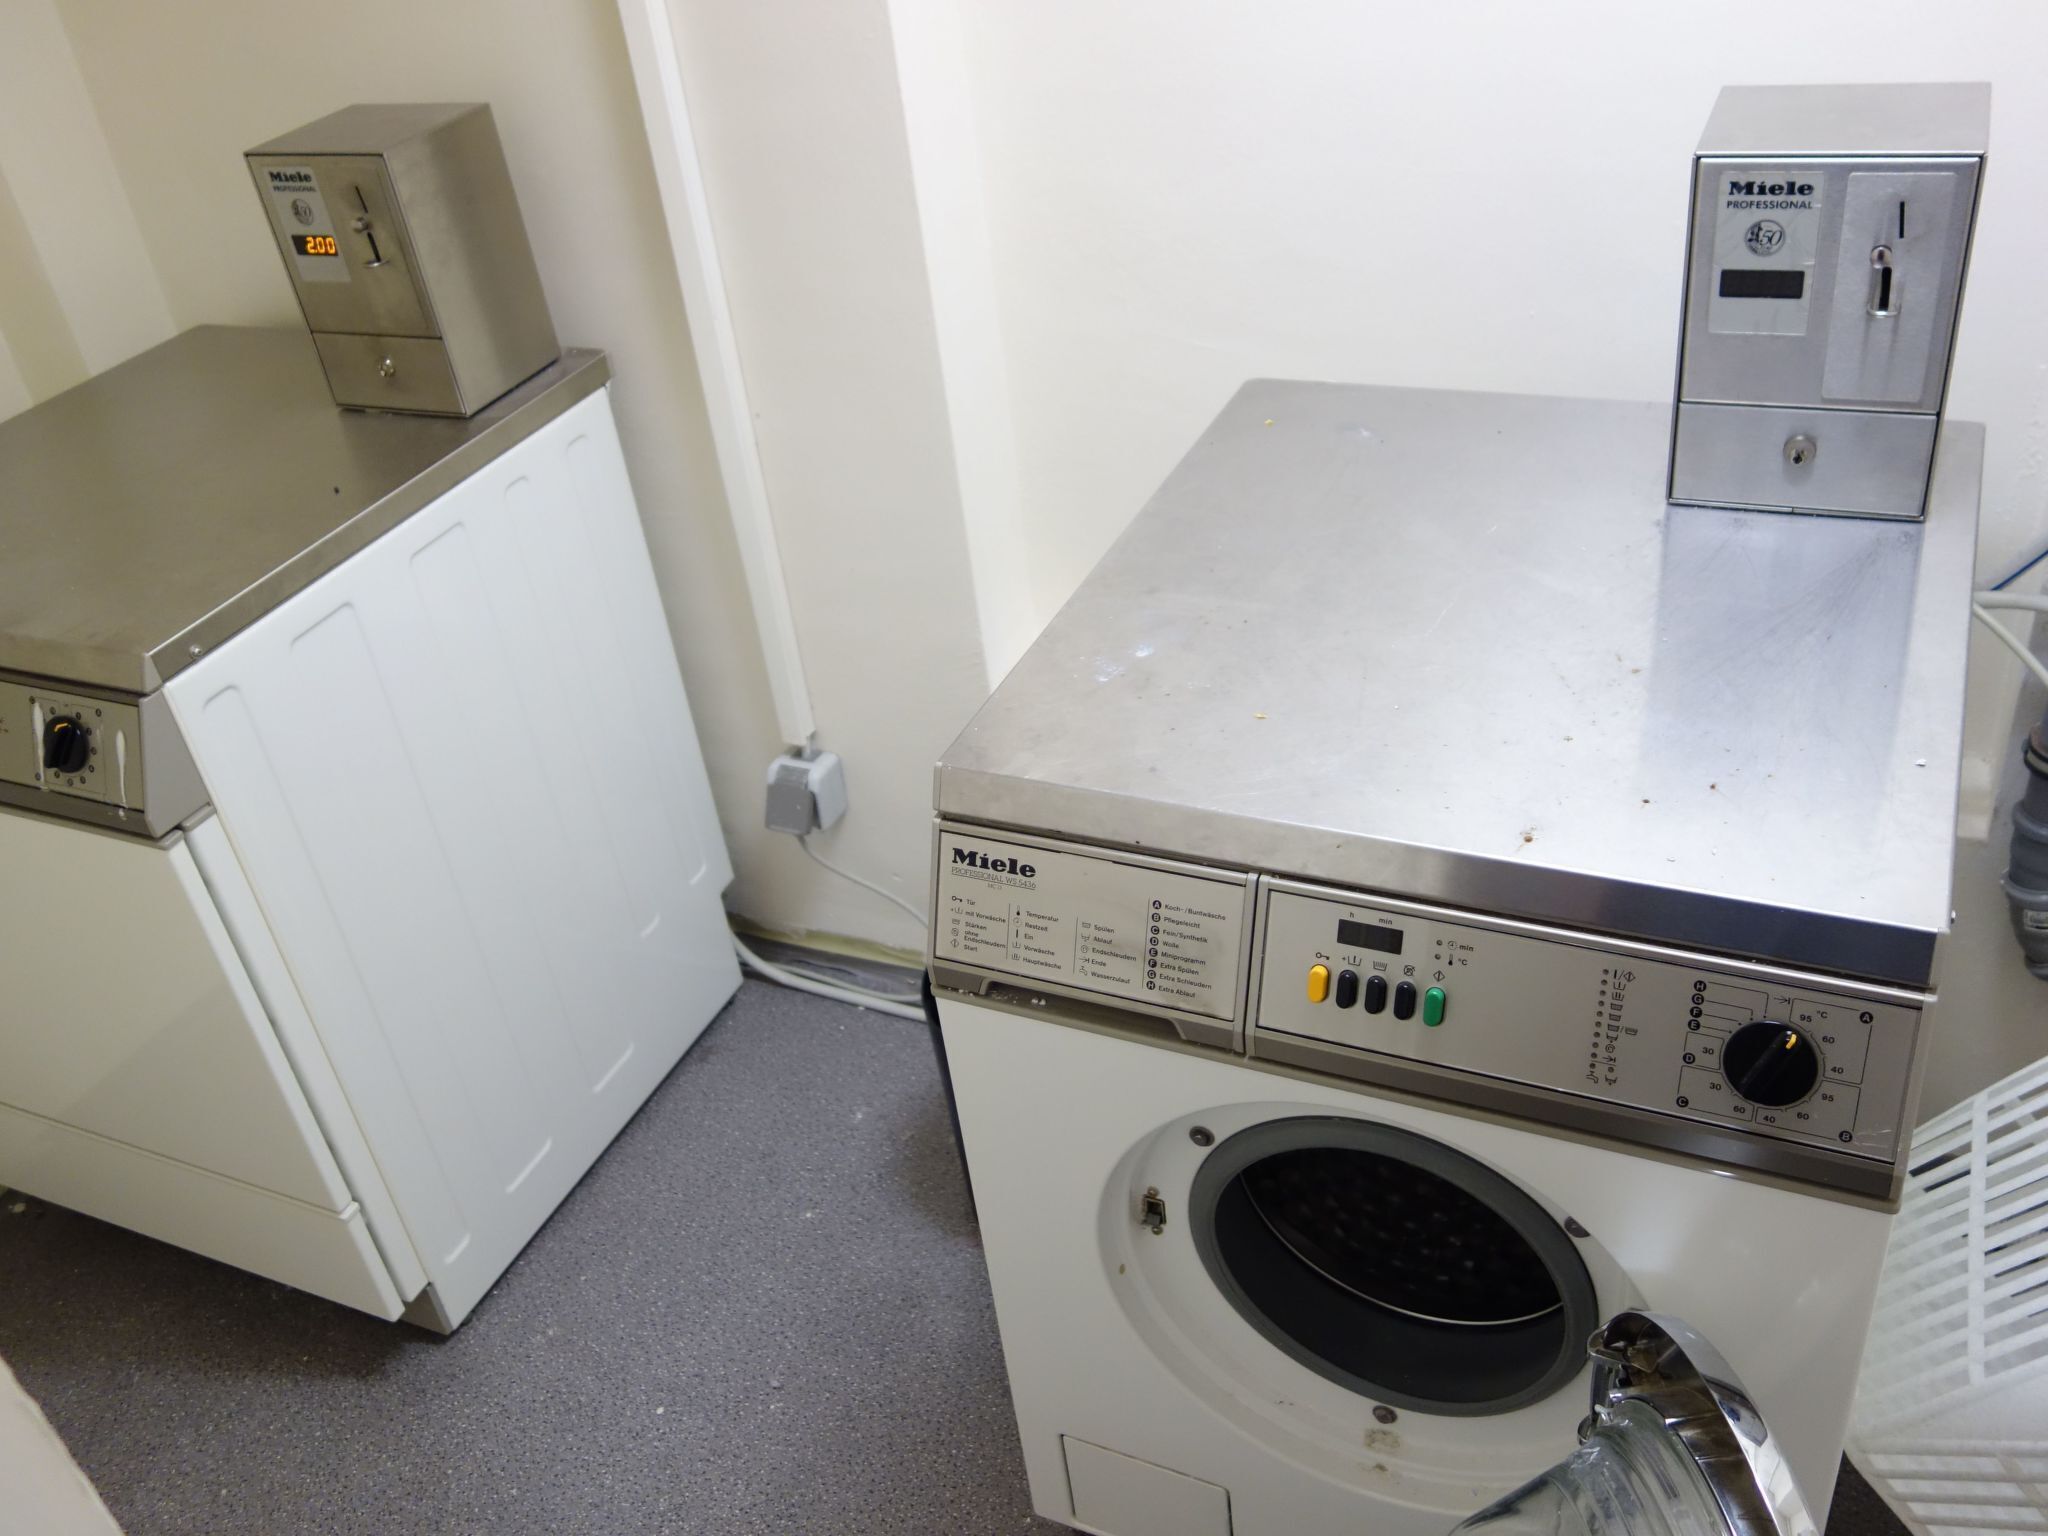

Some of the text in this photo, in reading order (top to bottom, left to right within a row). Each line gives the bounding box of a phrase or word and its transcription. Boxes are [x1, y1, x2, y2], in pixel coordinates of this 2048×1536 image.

[269, 171, 312, 182] Miele
[1728, 181, 1814, 196] Miele
[1726, 200, 1812, 209] PROFESSIONAL
[306, 237, 336, 254] 2.00
[952, 848, 1036, 878] Miele
[952, 867, 1036, 889] PROFESSIONAL WS 5436
[1094, 924, 1114, 934] Spülen
[1094, 936, 1113, 945] Ablauf
[964, 944, 978, 952] Start
[1024, 944, 1055, 956] Vorwäsche
[1092, 959, 1106, 967] Ende
[1161, 952, 1206, 966] Miniprogramm
[1160, 962, 1176, 971] Extra
[1178, 965, 1199, 976] Spülen
[1091, 970, 1130, 984] Wasserzulauf
[1160, 974, 1175, 982] Extra
[1158, 985, 1174, 994] Extra
[1695, 981, 1705, 992] H
[1693, 994, 1703, 1004] G
[1691, 1007, 1701, 1018] F
[1861, 1012, 1873, 1023] A
[1800, 1014, 1812, 1022] 95
[1689, 1020, 1699, 1030] E
[1822, 1036, 1835, 1044] 60
[1702, 1046, 1714, 1055] 30
[1830, 1066, 1844, 1074] 40
[1710, 1082, 1722, 1091] 30
[1677, 1097, 1688, 1107] C
[1822, 1094, 1834, 1102] 95
[1734, 1106, 1746, 1114] 60
[1763, 1116, 1776, 1124] 40
[1797, 1112, 1810, 1120] 60
[1840, 1131, 1852, 1142] B
